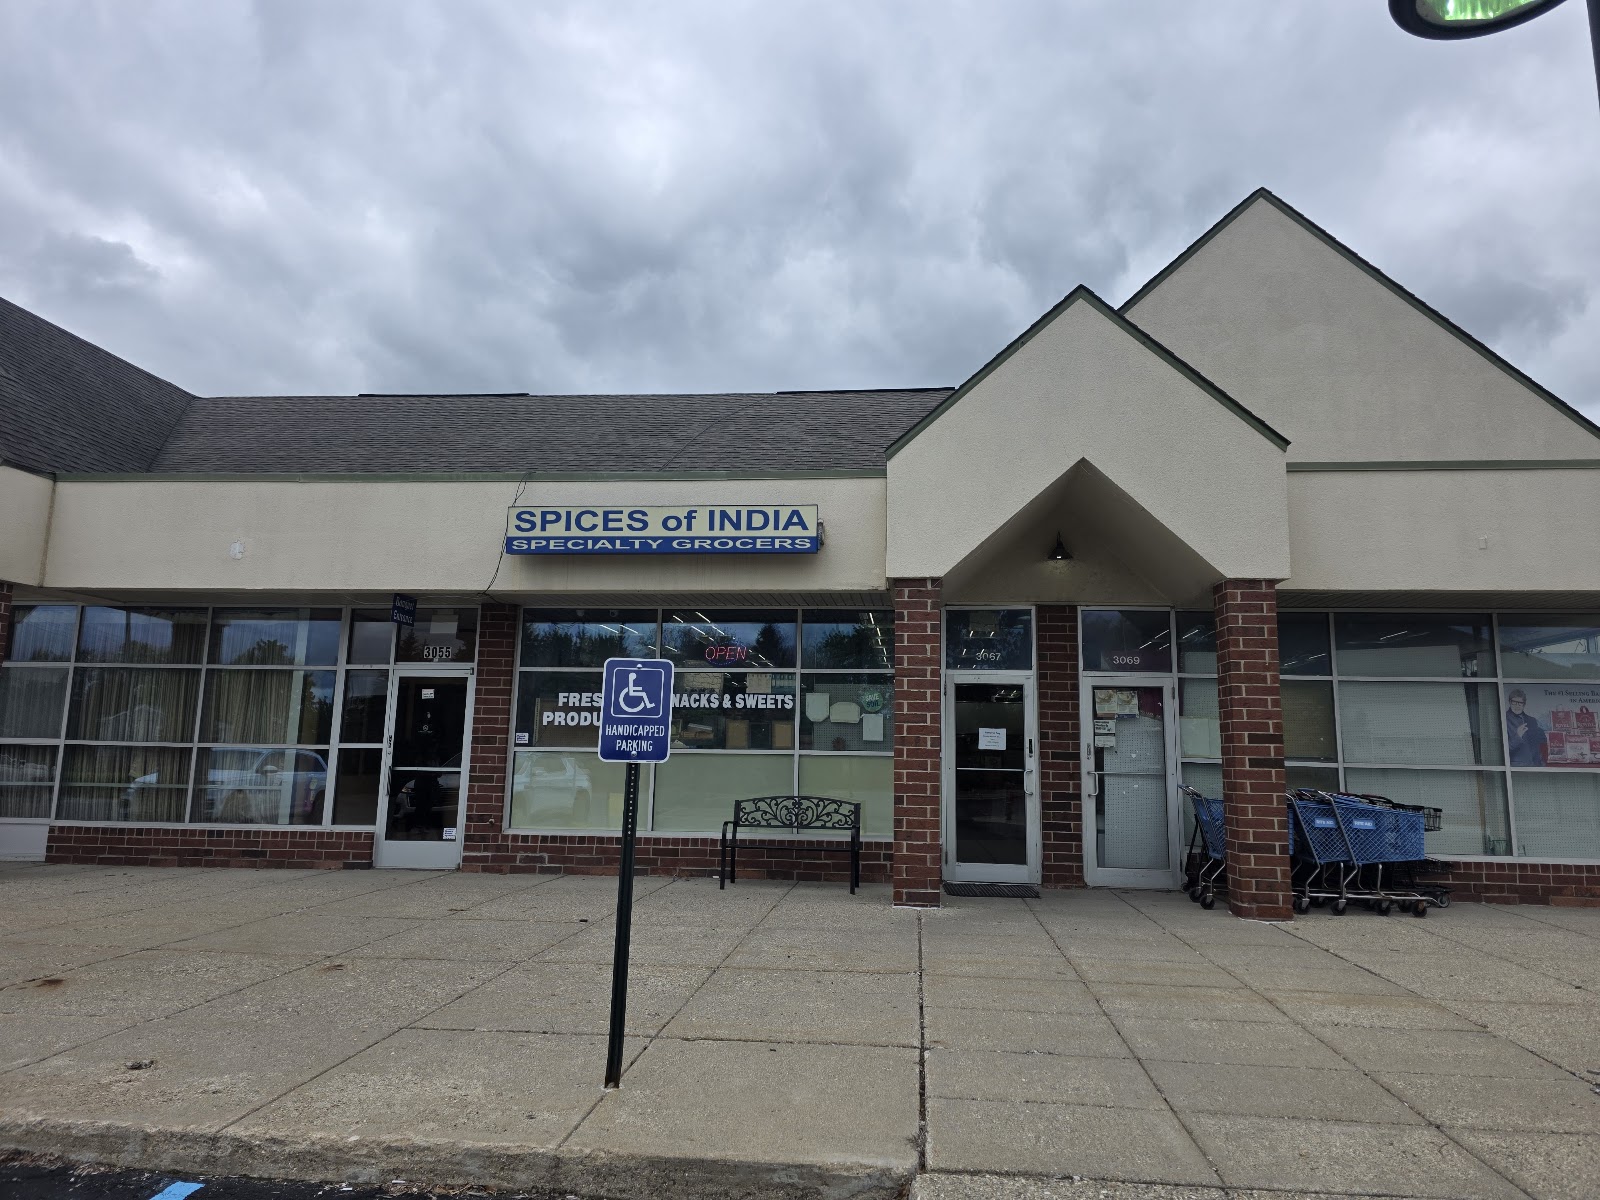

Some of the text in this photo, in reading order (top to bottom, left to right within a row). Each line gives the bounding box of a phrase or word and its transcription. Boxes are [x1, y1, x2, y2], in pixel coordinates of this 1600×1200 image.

[514, 509, 809, 533] SPICES of INDIA
[511, 538, 811, 550] SPECIALTY GROCERS
[424, 646, 451, 658] 3055
[705, 646, 747, 660] OPEN
[975, 652, 1001, 661] 3067
[1112, 656, 1140, 665] 3069
[558, 692, 603, 707] FRES
[672, 693, 794, 709] NACKS & SWEETS
[542, 711, 601, 727] PRODU
[605, 724, 665, 737] HANDICAPPED
[615, 740, 653, 752] PARKING
